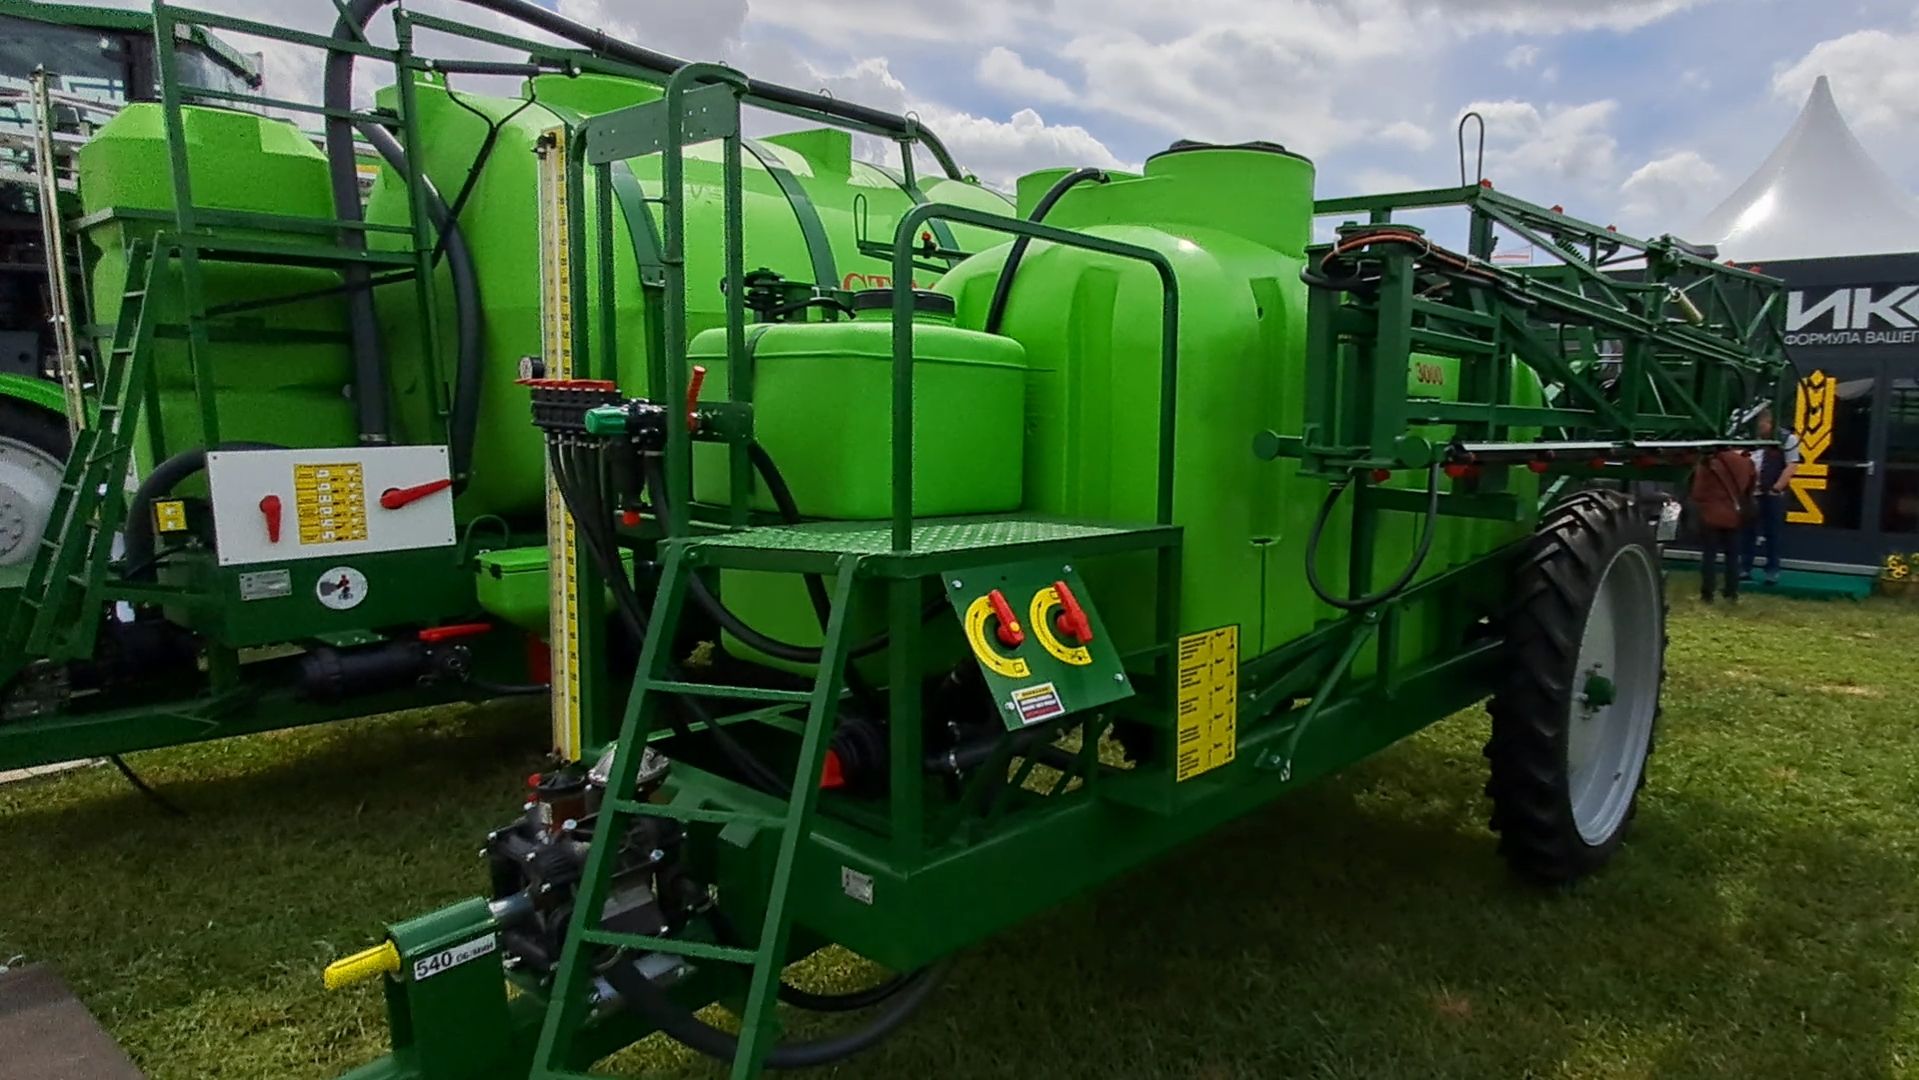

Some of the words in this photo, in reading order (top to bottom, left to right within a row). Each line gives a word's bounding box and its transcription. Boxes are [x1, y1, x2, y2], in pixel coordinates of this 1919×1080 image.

[1783, 332, 1861, 346] ФОРМУЛА
[1417, 362, 1444, 386] 3000
[416, 951, 452, 977] 540
